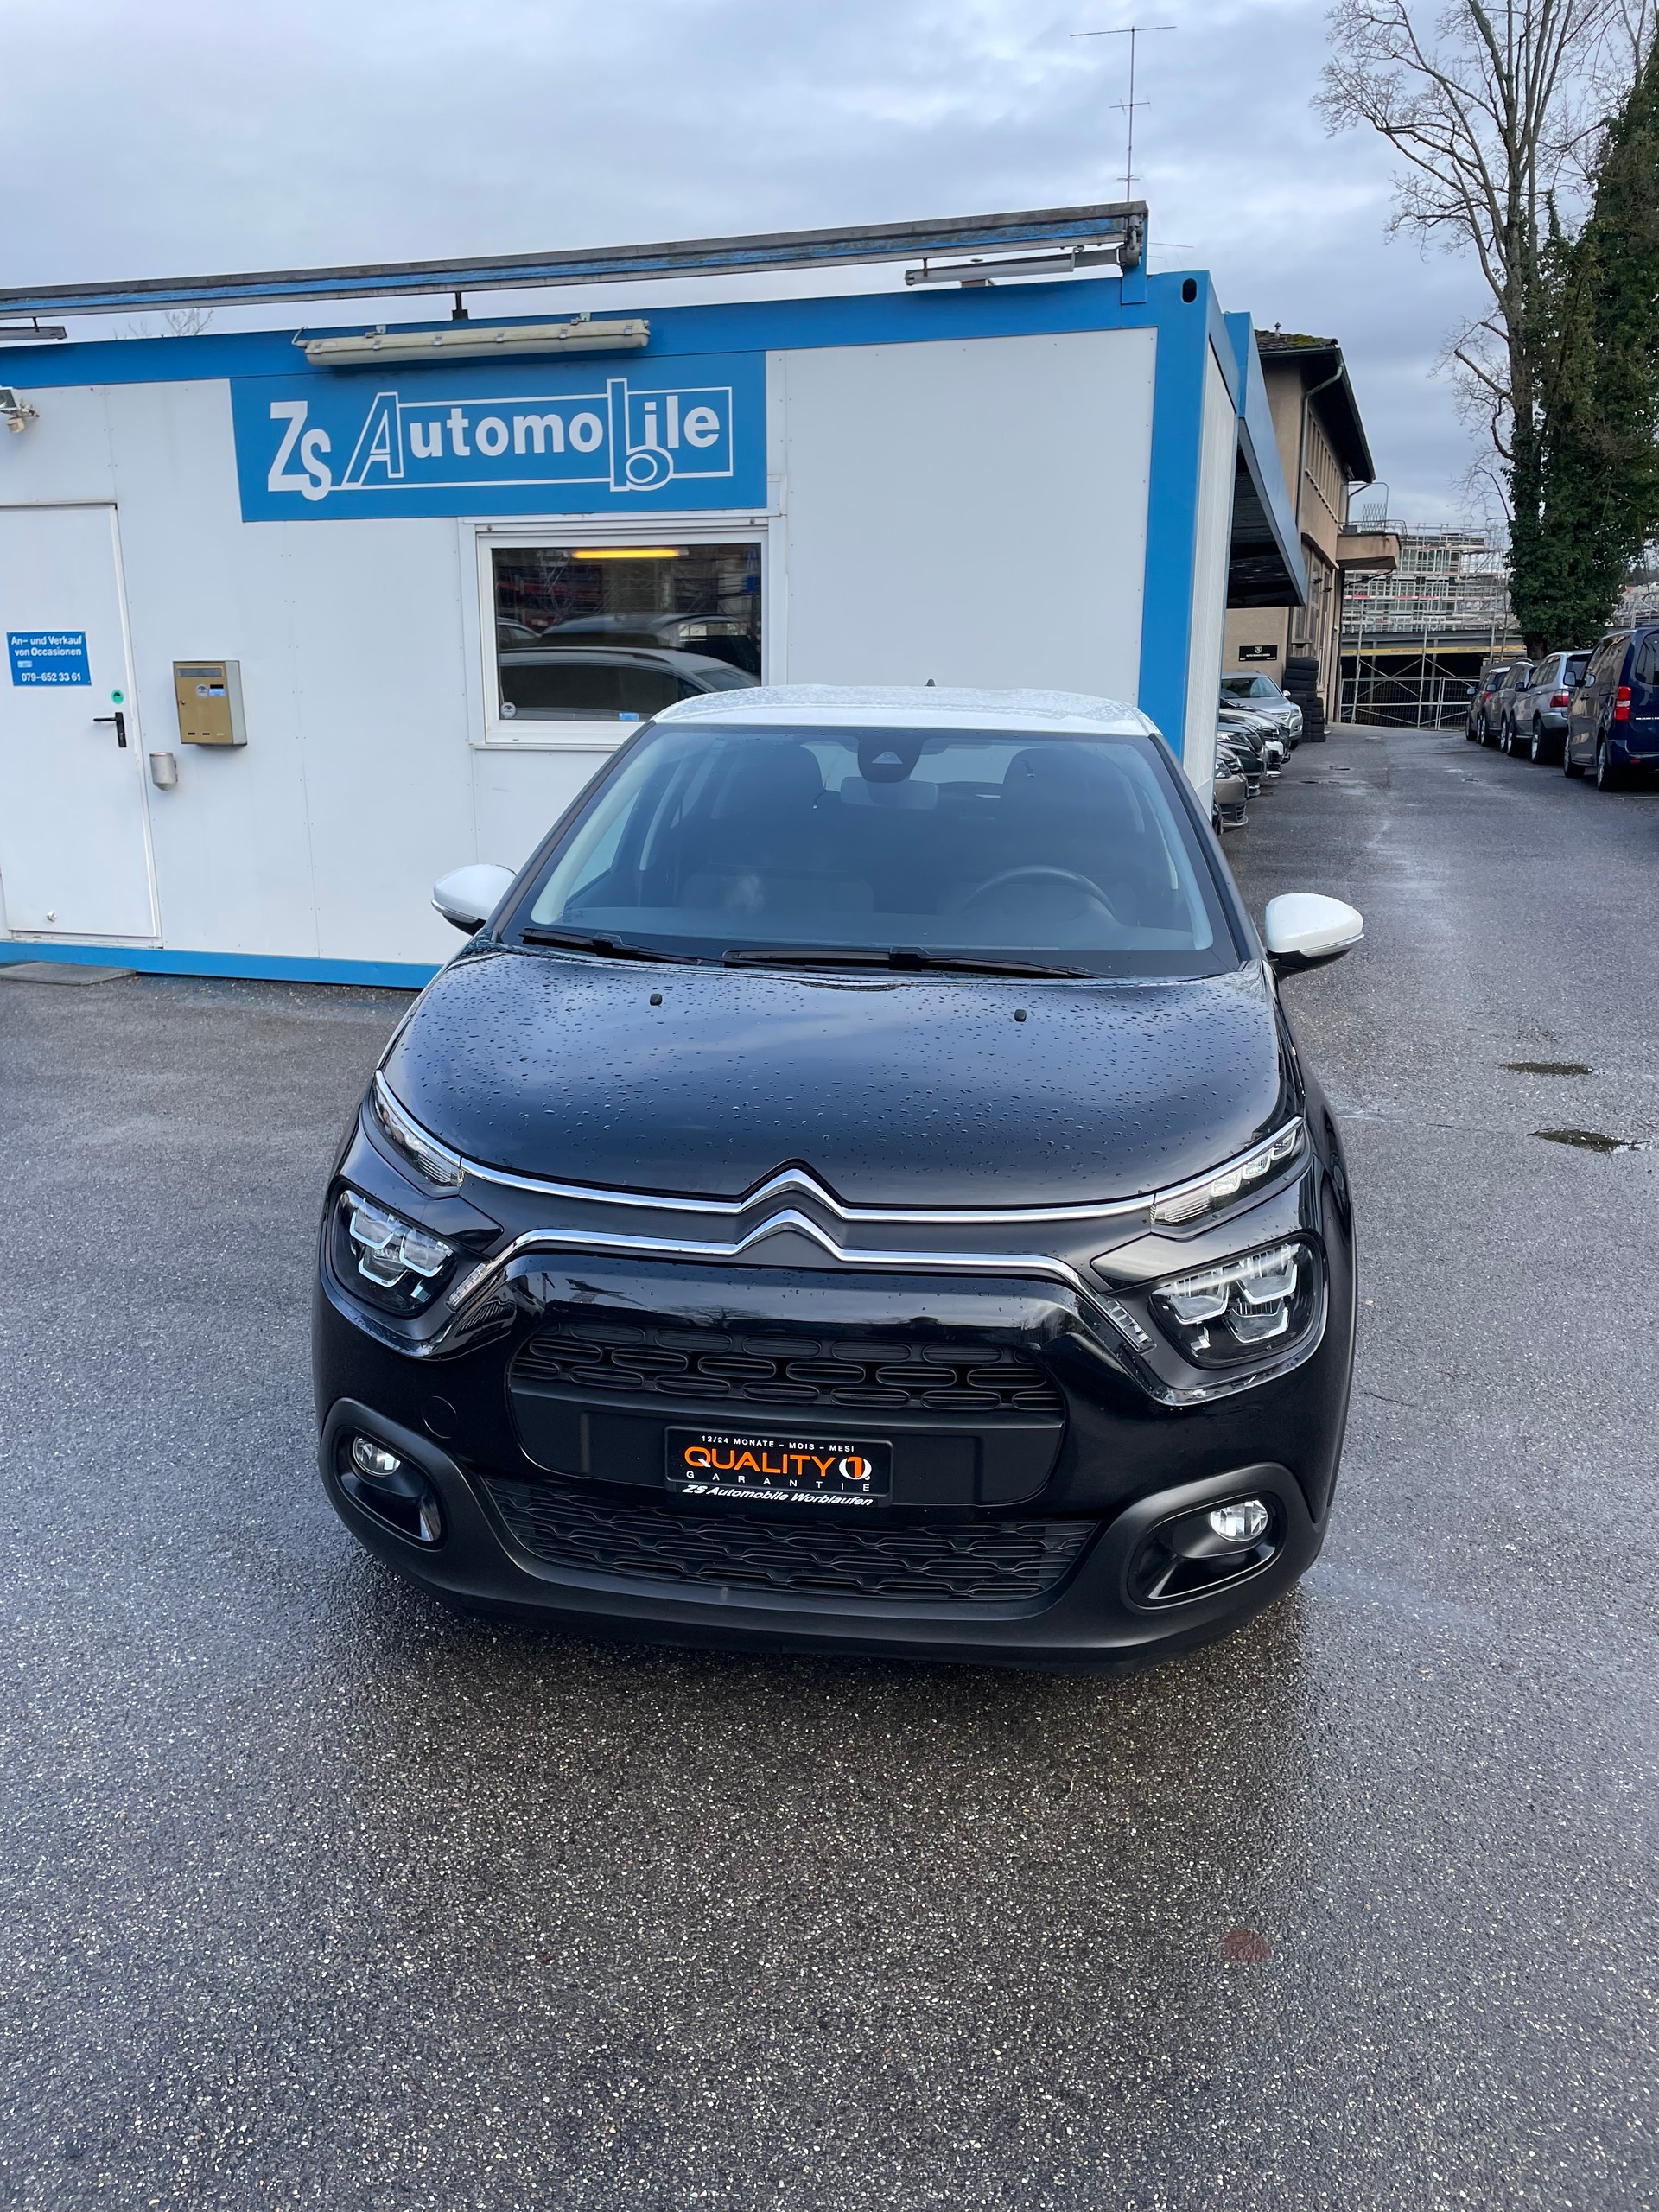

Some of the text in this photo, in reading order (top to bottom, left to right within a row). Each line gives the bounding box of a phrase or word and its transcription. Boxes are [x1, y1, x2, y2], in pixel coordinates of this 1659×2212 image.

[341, 378, 720, 491] Automobile
[11, 635, 82, 645] An- und Verkauf
[31, 646, 82, 656] Occasionen
[22, 672, 81, 682] 079-652 33 61
[702, 1435, 728, 1444] 12/24
[734, 1438, 774, 1447] MONATE
[789, 1442, 815, 1451] MOIS
[684, 1446, 836, 1477] QUALITY
[686, 1471, 870, 1491] GARANTIE
[682, 1484, 874, 1506] ZS Automobile Worblaufen
